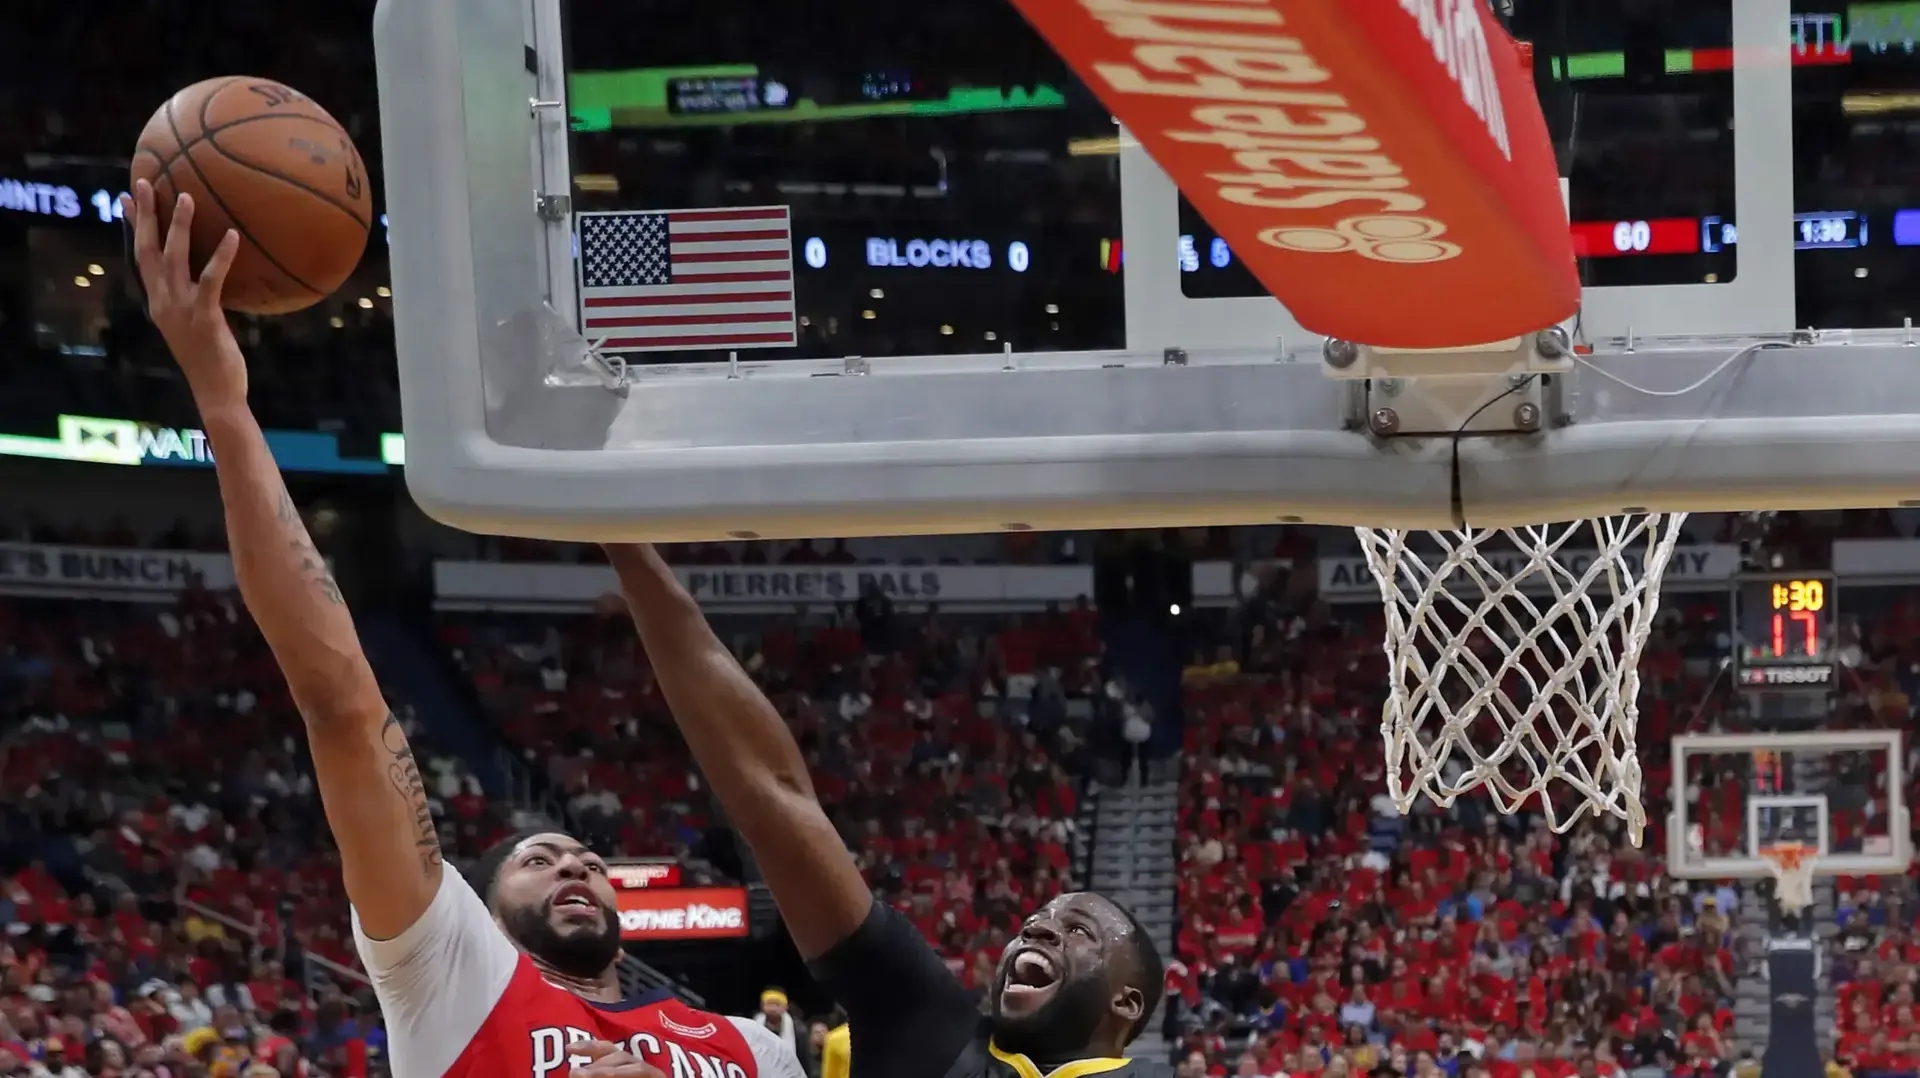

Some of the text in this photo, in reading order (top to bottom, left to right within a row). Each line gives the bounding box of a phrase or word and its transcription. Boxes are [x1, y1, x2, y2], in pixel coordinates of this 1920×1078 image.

[0, 178, 81, 218] INTS
[1613, 220, 1650, 251] 60
[805, 237, 827, 268] 0
[866, 237, 1029, 272] BLOCKS 0
[138, 426, 216, 463] WAIT
[688, 571, 847, 597] PIERRE'S
[1772, 581, 1824, 612] 1:30
[1772, 611, 1817, 657] 17
[1765, 666, 1832, 683] TISSOT
